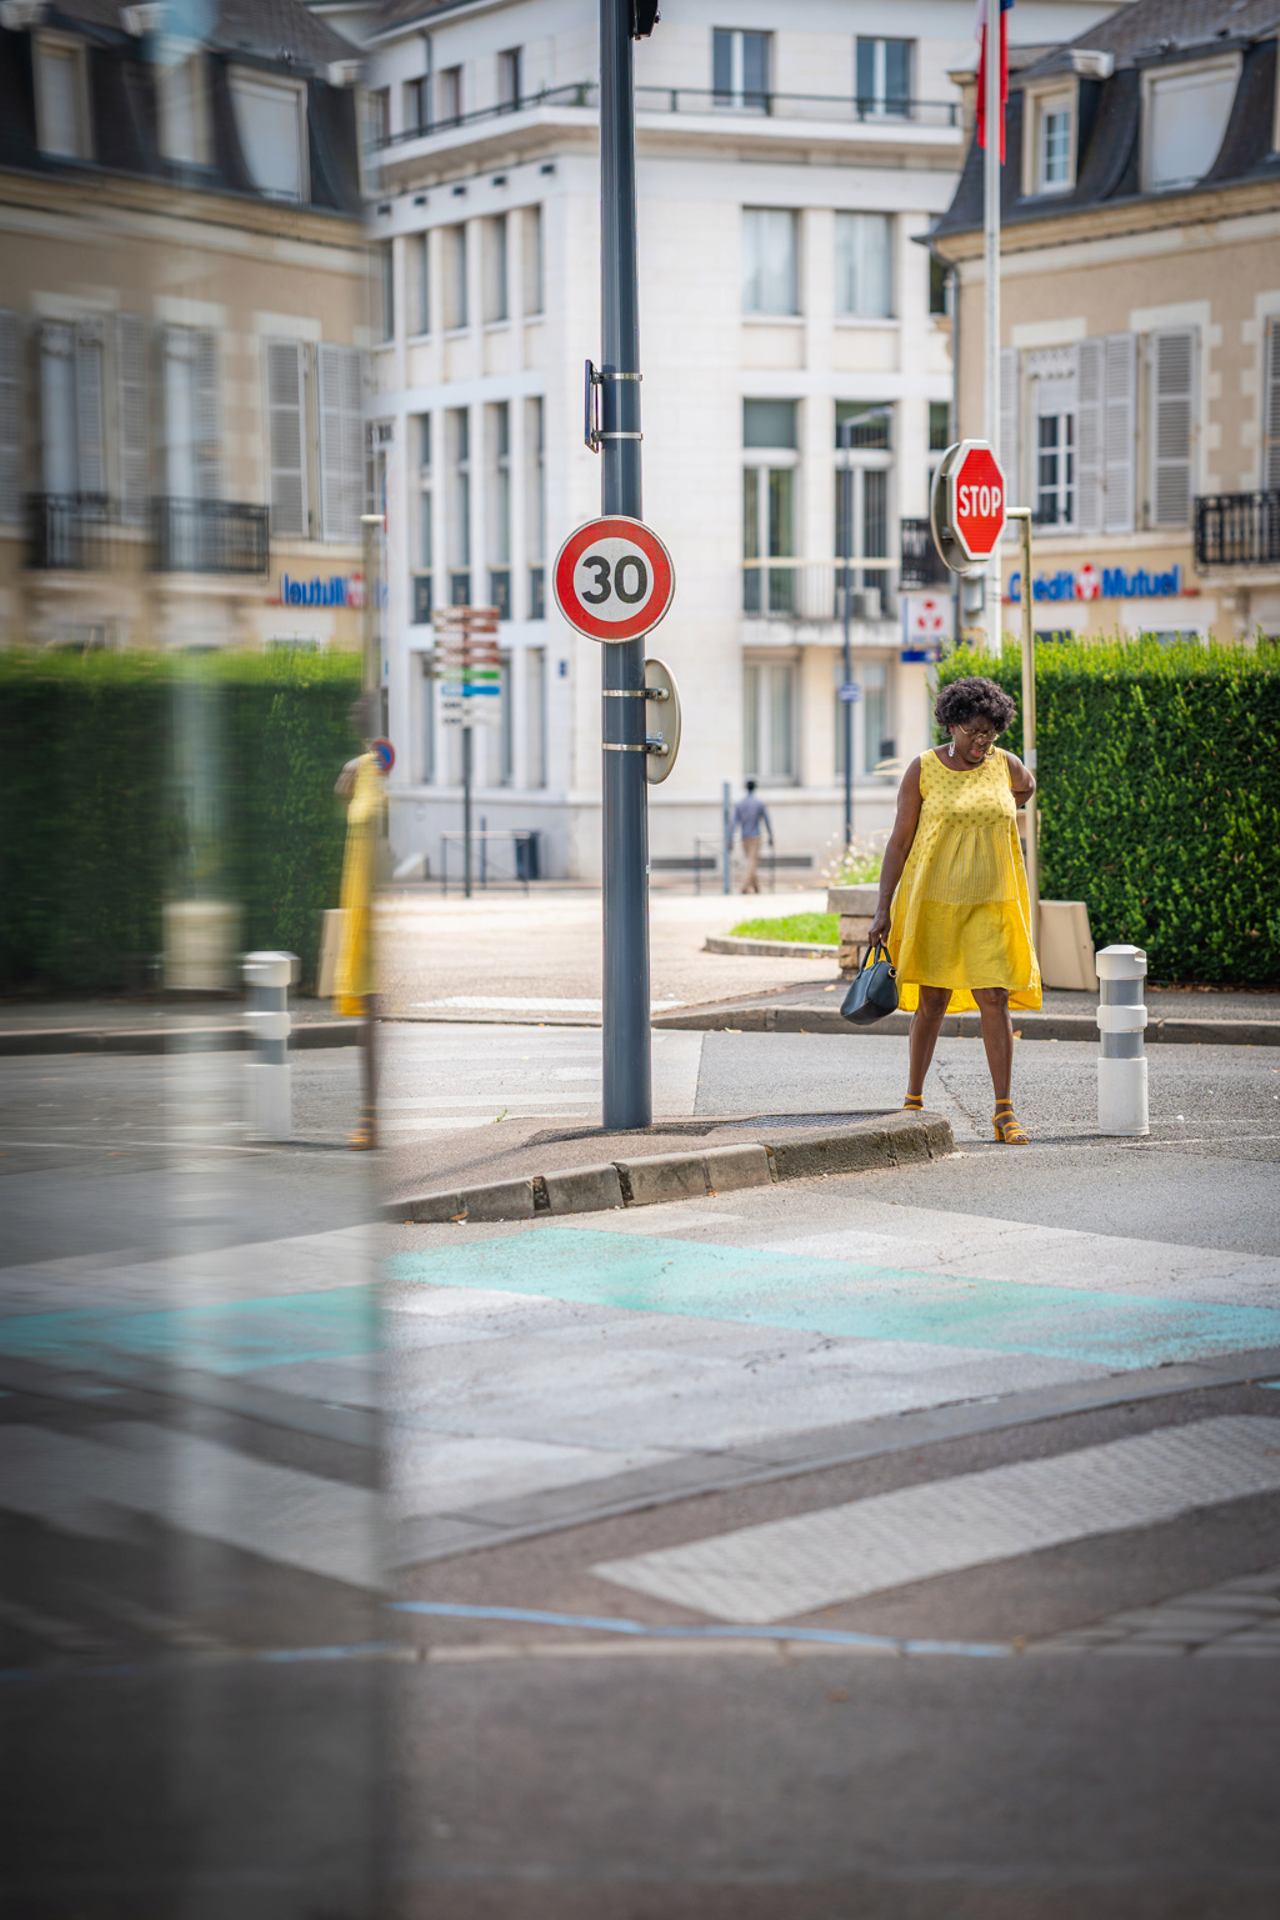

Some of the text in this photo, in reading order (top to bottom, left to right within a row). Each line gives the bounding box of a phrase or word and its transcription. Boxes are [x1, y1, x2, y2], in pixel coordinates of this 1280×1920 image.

[959, 485, 1002, 518] STOP
[581, 555, 648, 605] 30
[1008, 565, 1179, 602] Cédit Mutuel
